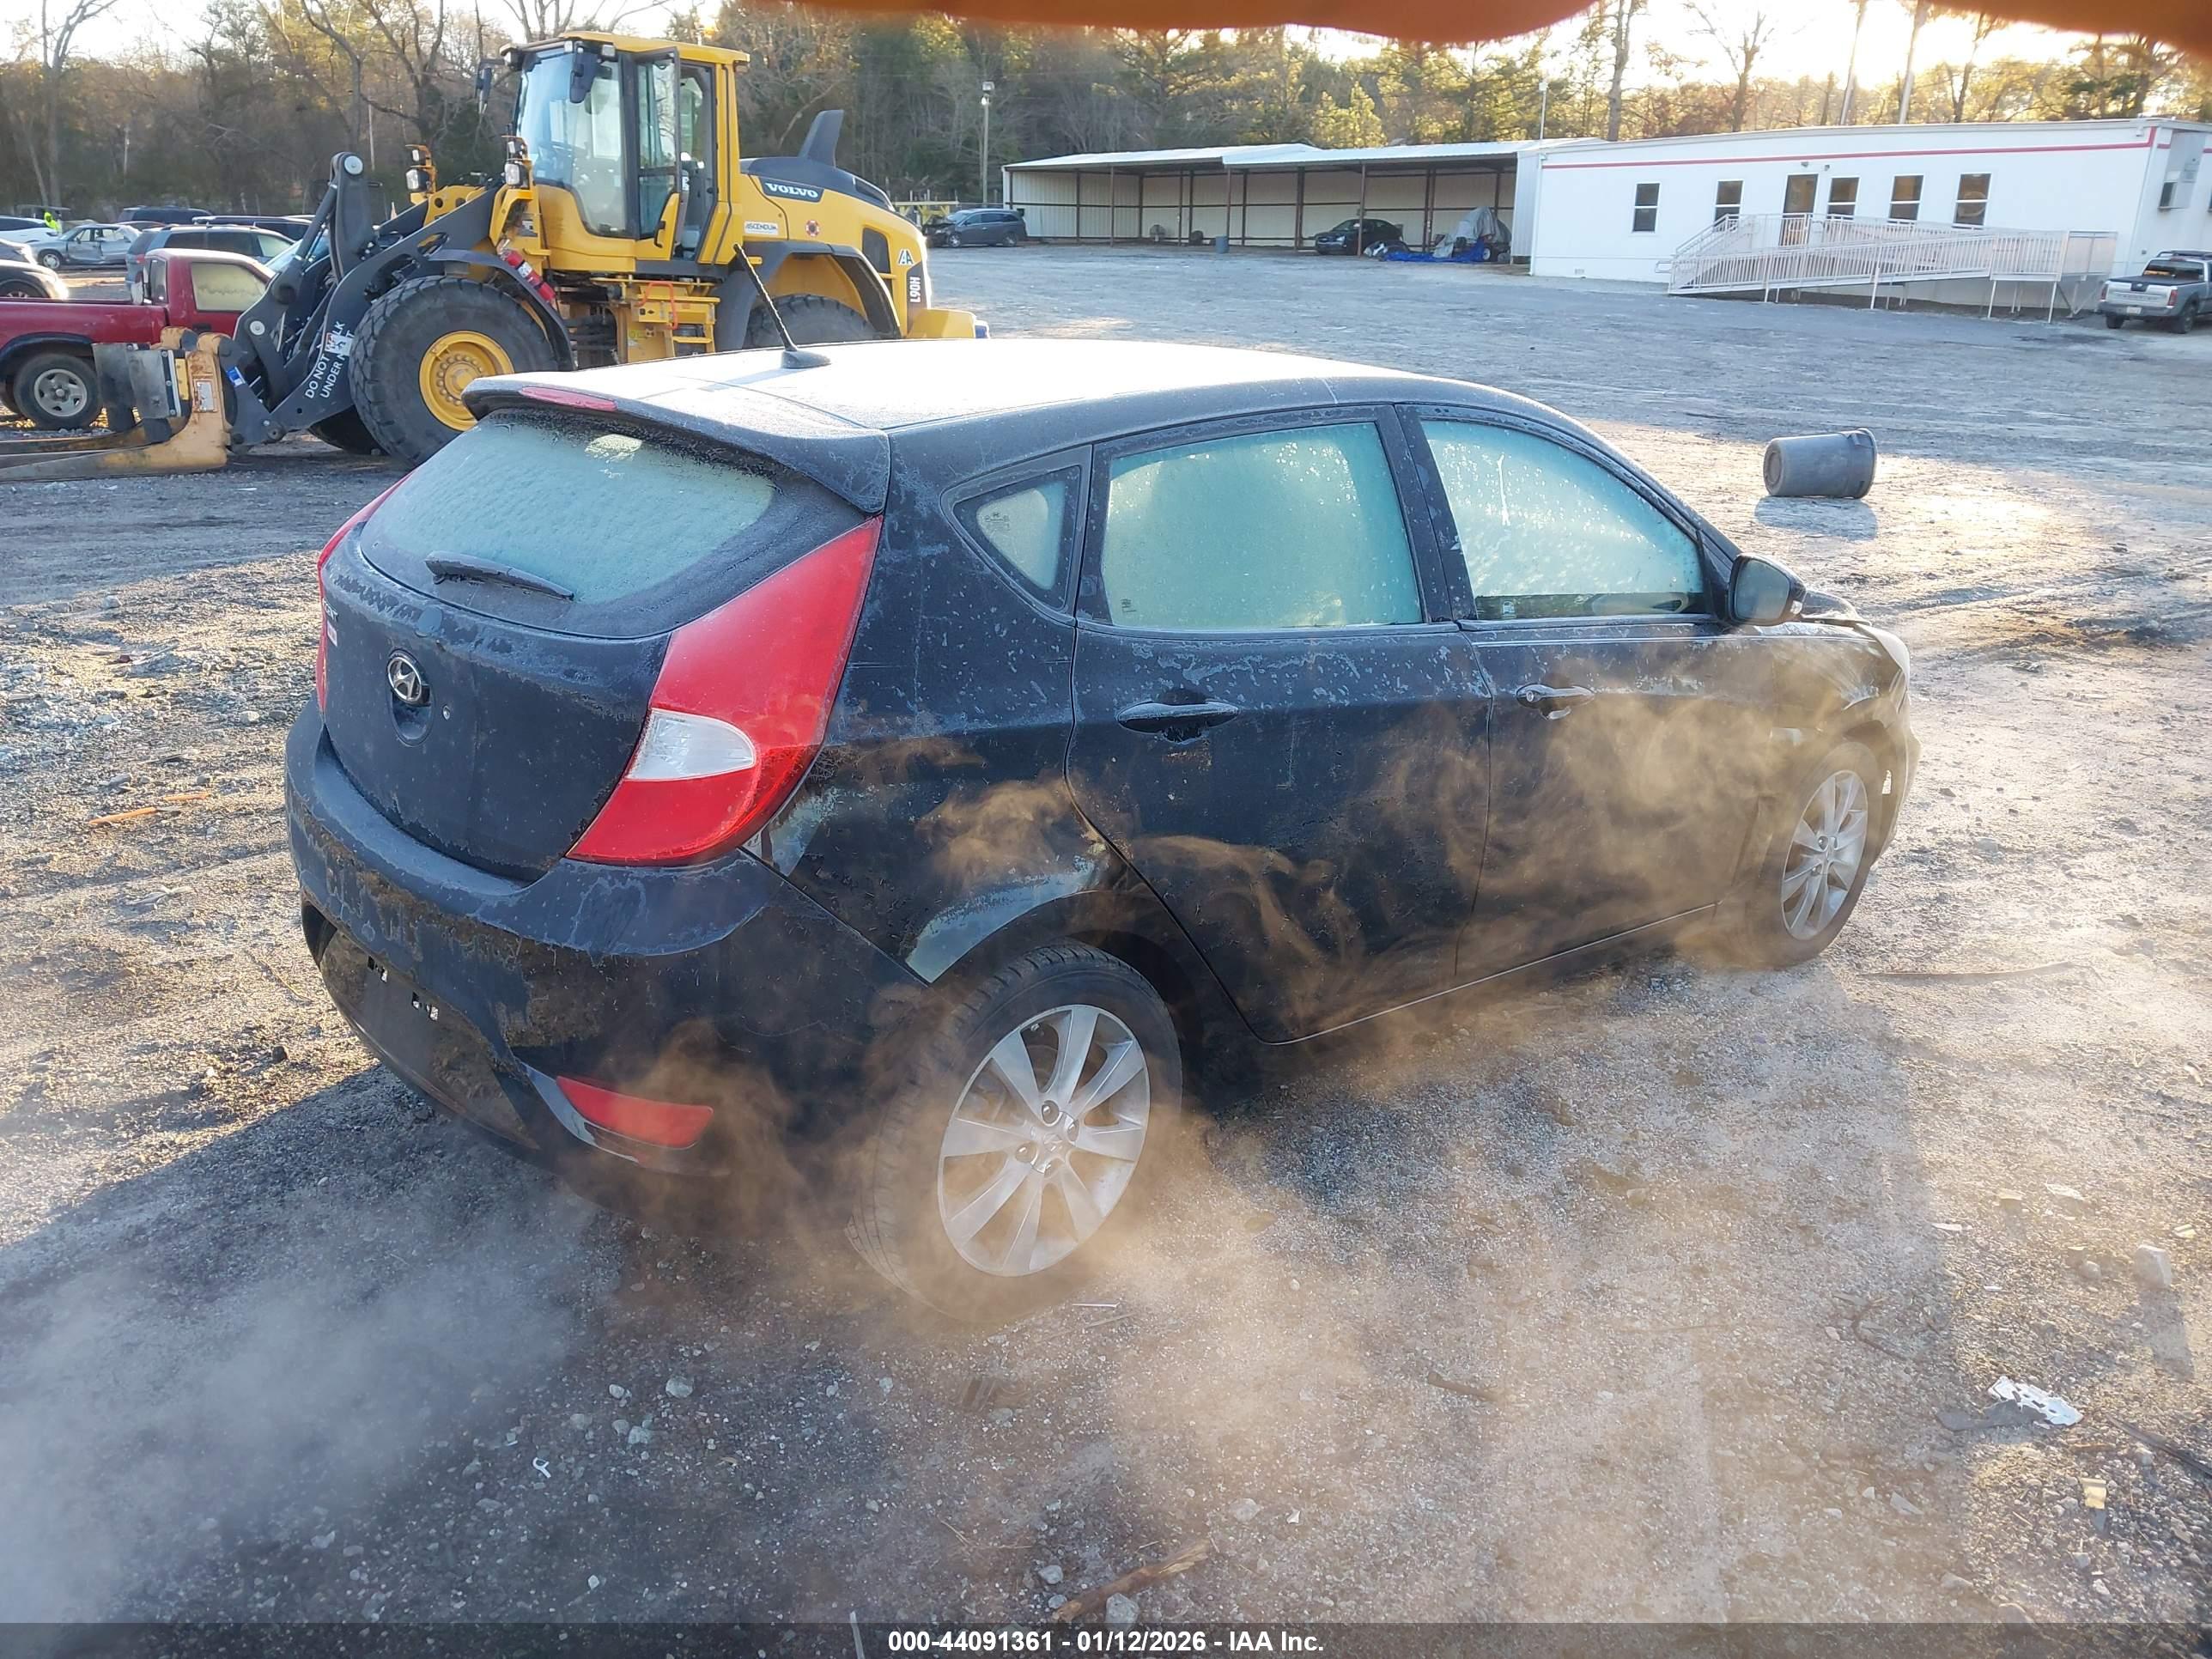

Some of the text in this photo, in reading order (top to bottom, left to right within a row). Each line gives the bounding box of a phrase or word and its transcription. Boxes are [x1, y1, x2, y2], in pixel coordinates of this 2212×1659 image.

[765, 183, 818, 198] VOLVO
[909, 276, 921, 303] L90H
[305, 380, 319, 398] DO
[313, 353, 330, 380] NOT
[319, 362, 343, 398] UNDER
